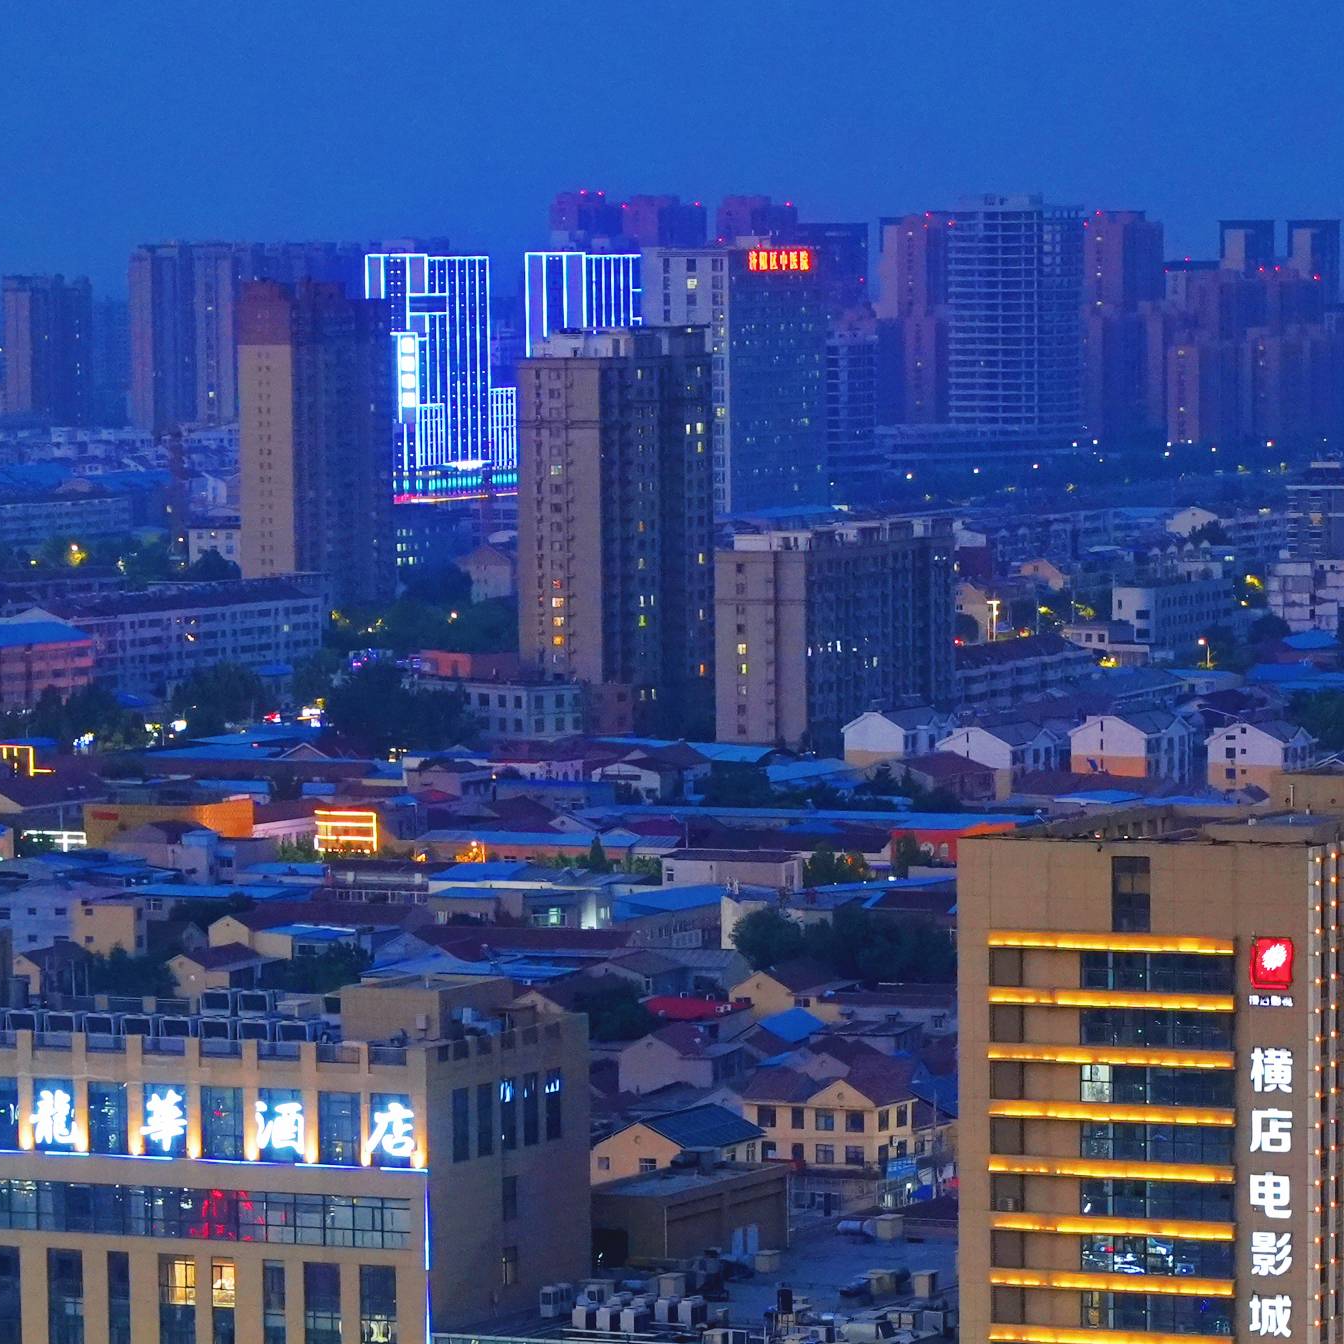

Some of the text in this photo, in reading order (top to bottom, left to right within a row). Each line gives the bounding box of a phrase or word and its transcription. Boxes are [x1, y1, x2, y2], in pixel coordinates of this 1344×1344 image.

[1248, 1046, 1294, 1339] 横店电影城
